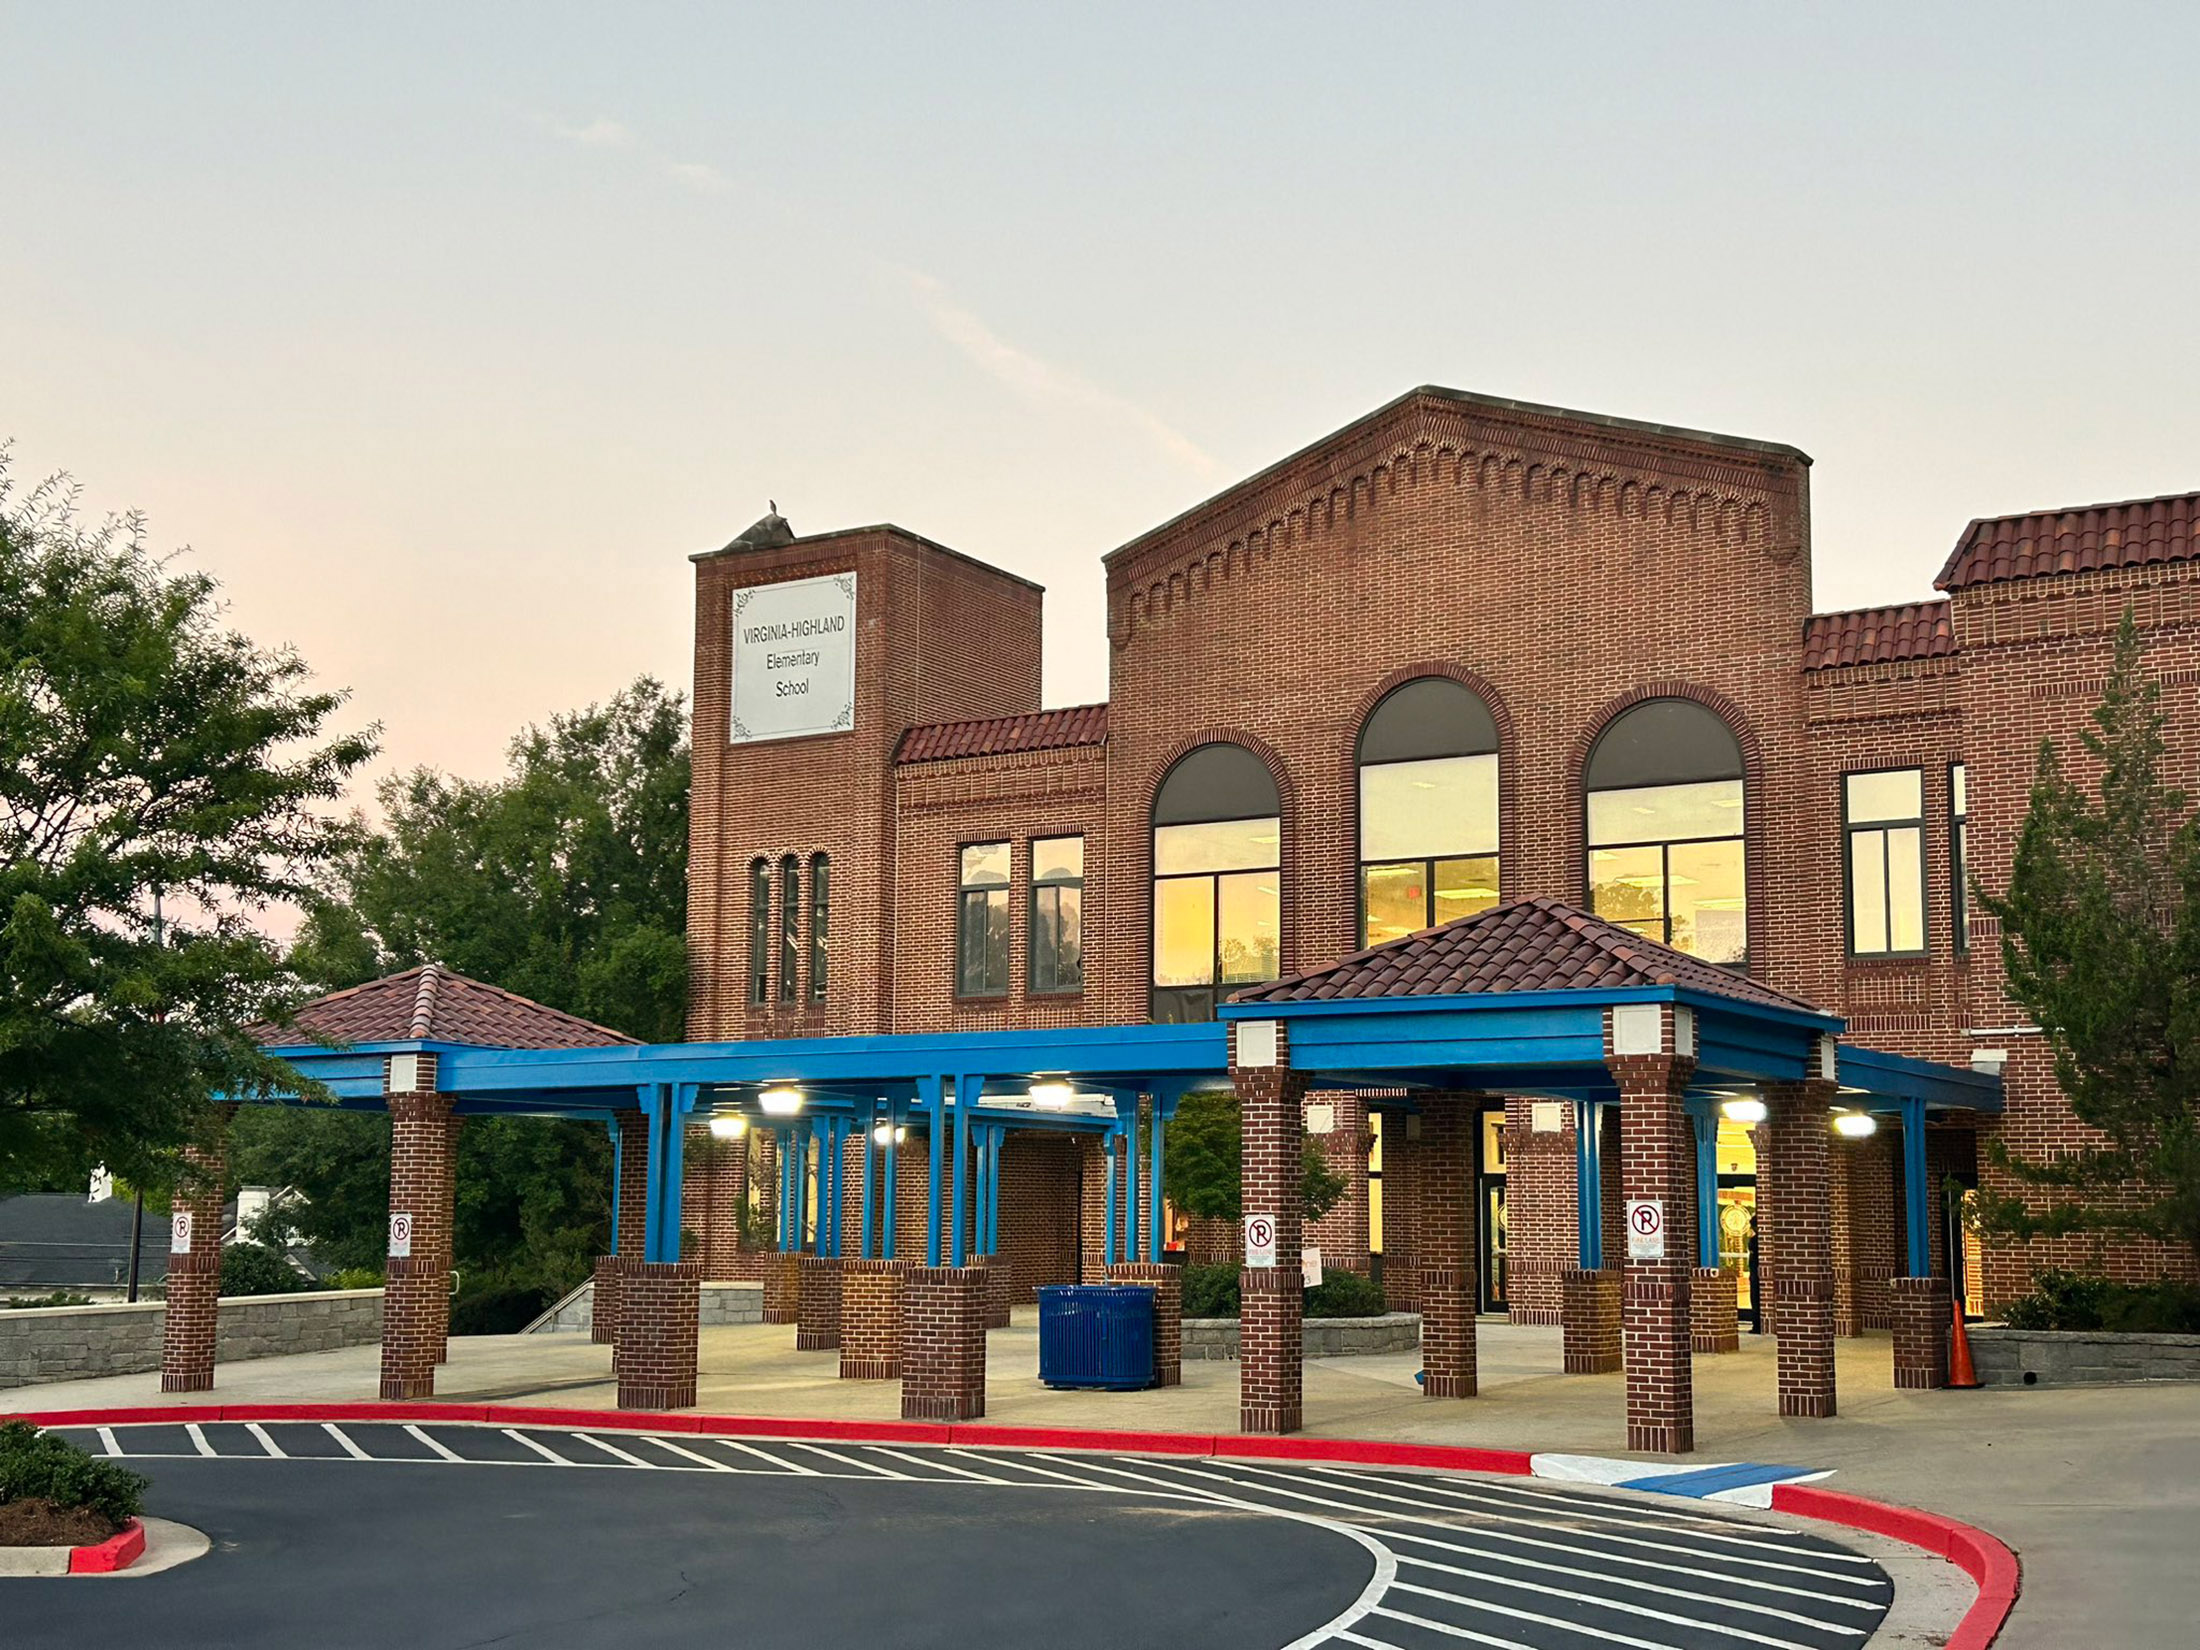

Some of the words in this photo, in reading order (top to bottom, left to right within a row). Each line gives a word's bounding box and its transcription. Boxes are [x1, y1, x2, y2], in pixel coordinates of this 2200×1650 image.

[744, 616, 845, 644] VIRGINIA-HIGHLAND
[767, 650, 820, 669] Elementary
[776, 678, 808, 697] School
